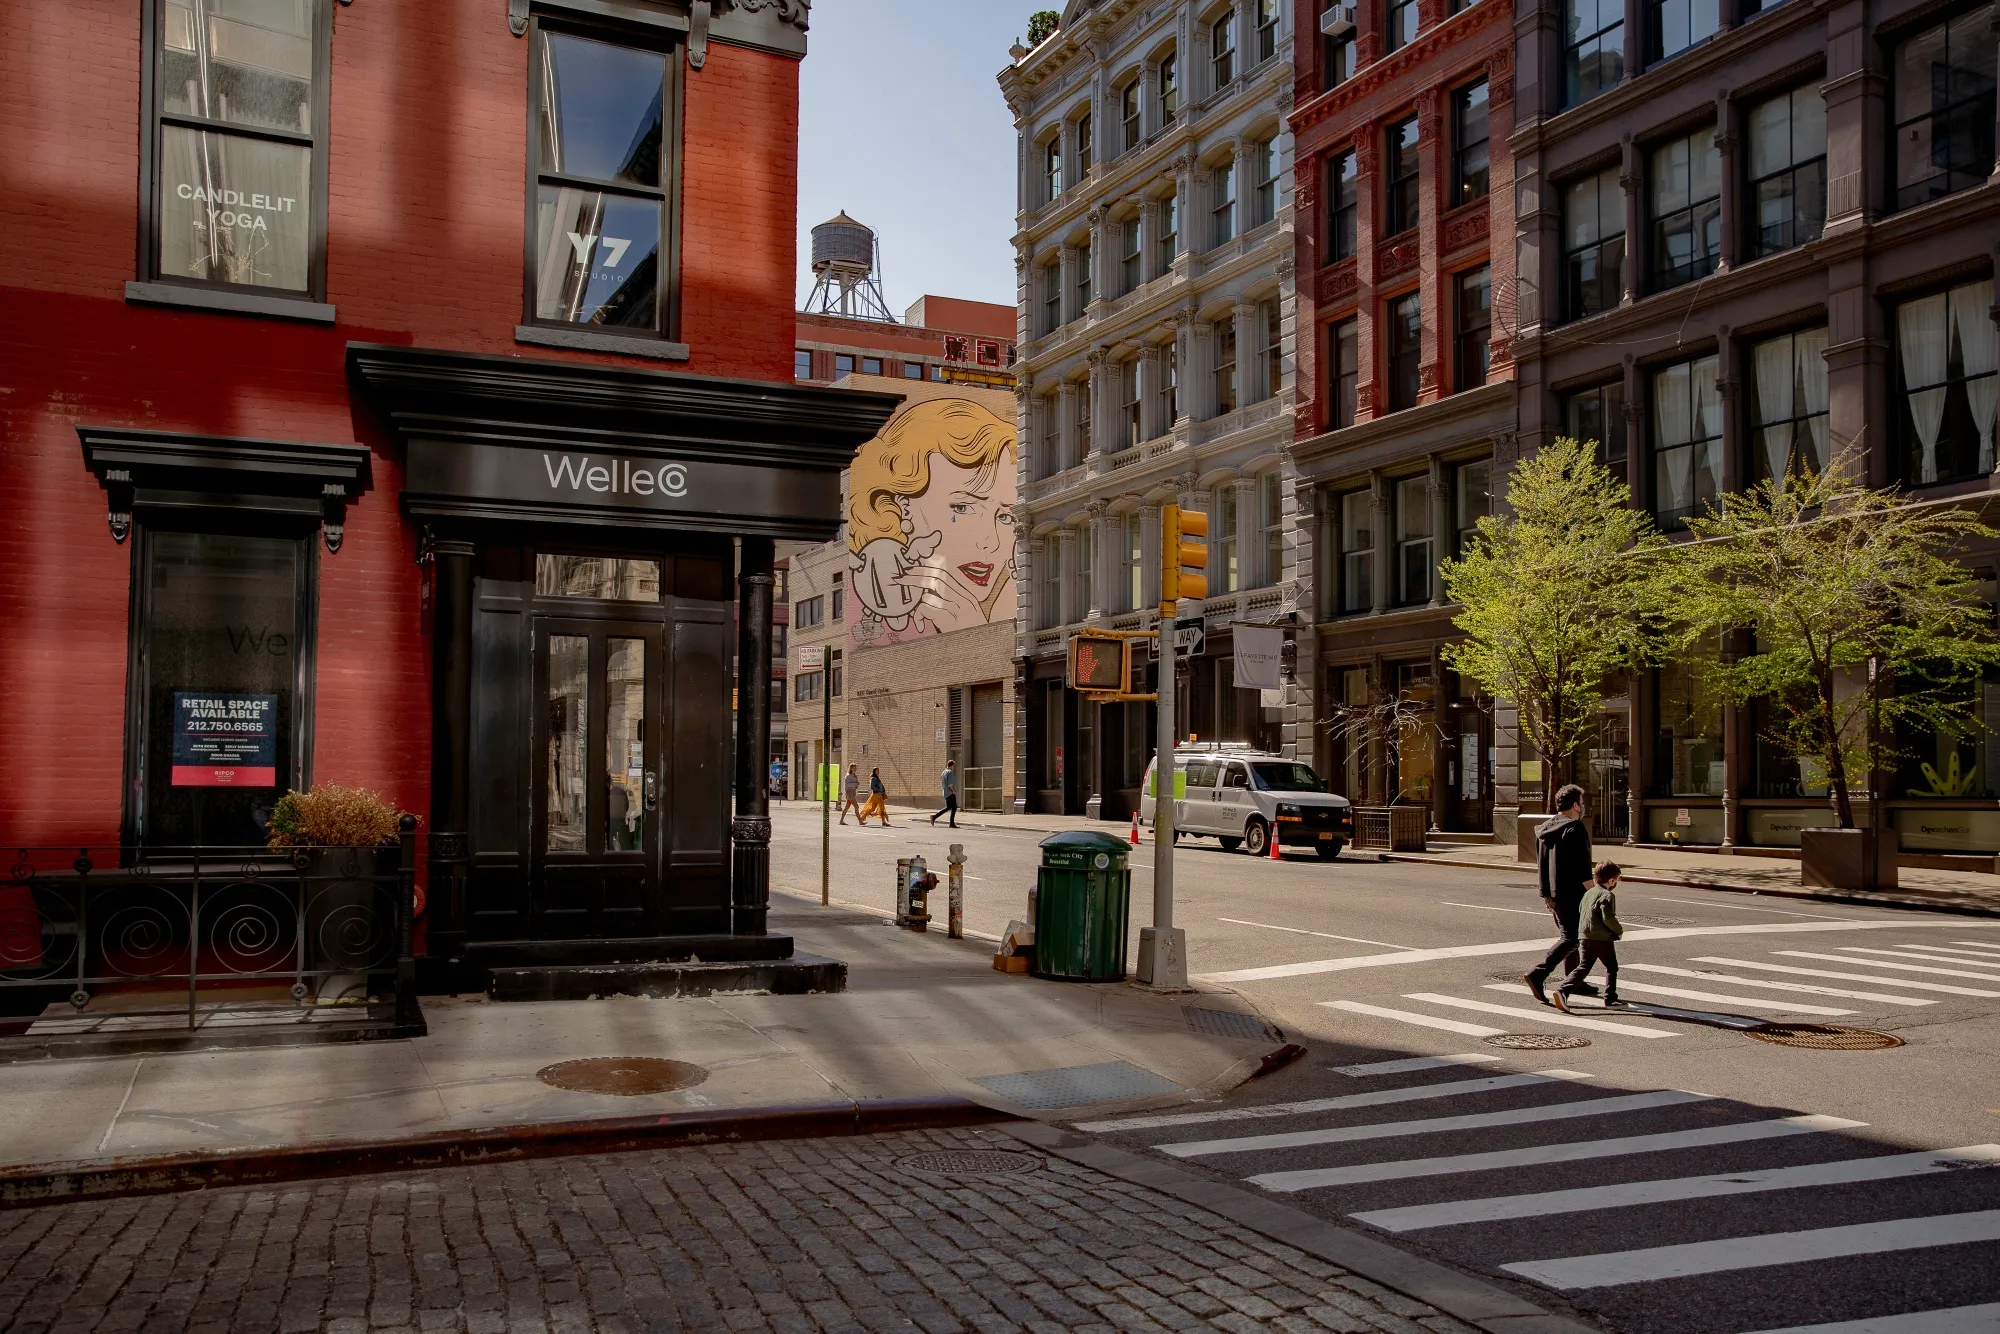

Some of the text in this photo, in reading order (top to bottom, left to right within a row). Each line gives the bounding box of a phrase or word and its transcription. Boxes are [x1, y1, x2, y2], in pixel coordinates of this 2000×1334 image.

[177, 183, 296, 213] CANDLELIT
[206, 208, 267, 231] YOGA
[566, 231, 633, 268] Y7
[574, 270, 624, 282] STUDIO
[543, 454, 688, 498] WelleCo
[1178, 629, 1197, 646] WAY
[182, 699, 269, 710] RETAIL SPACE
[190, 708, 260, 719] AVAILABLE
[187, 721, 263, 732] 212.750.6565
